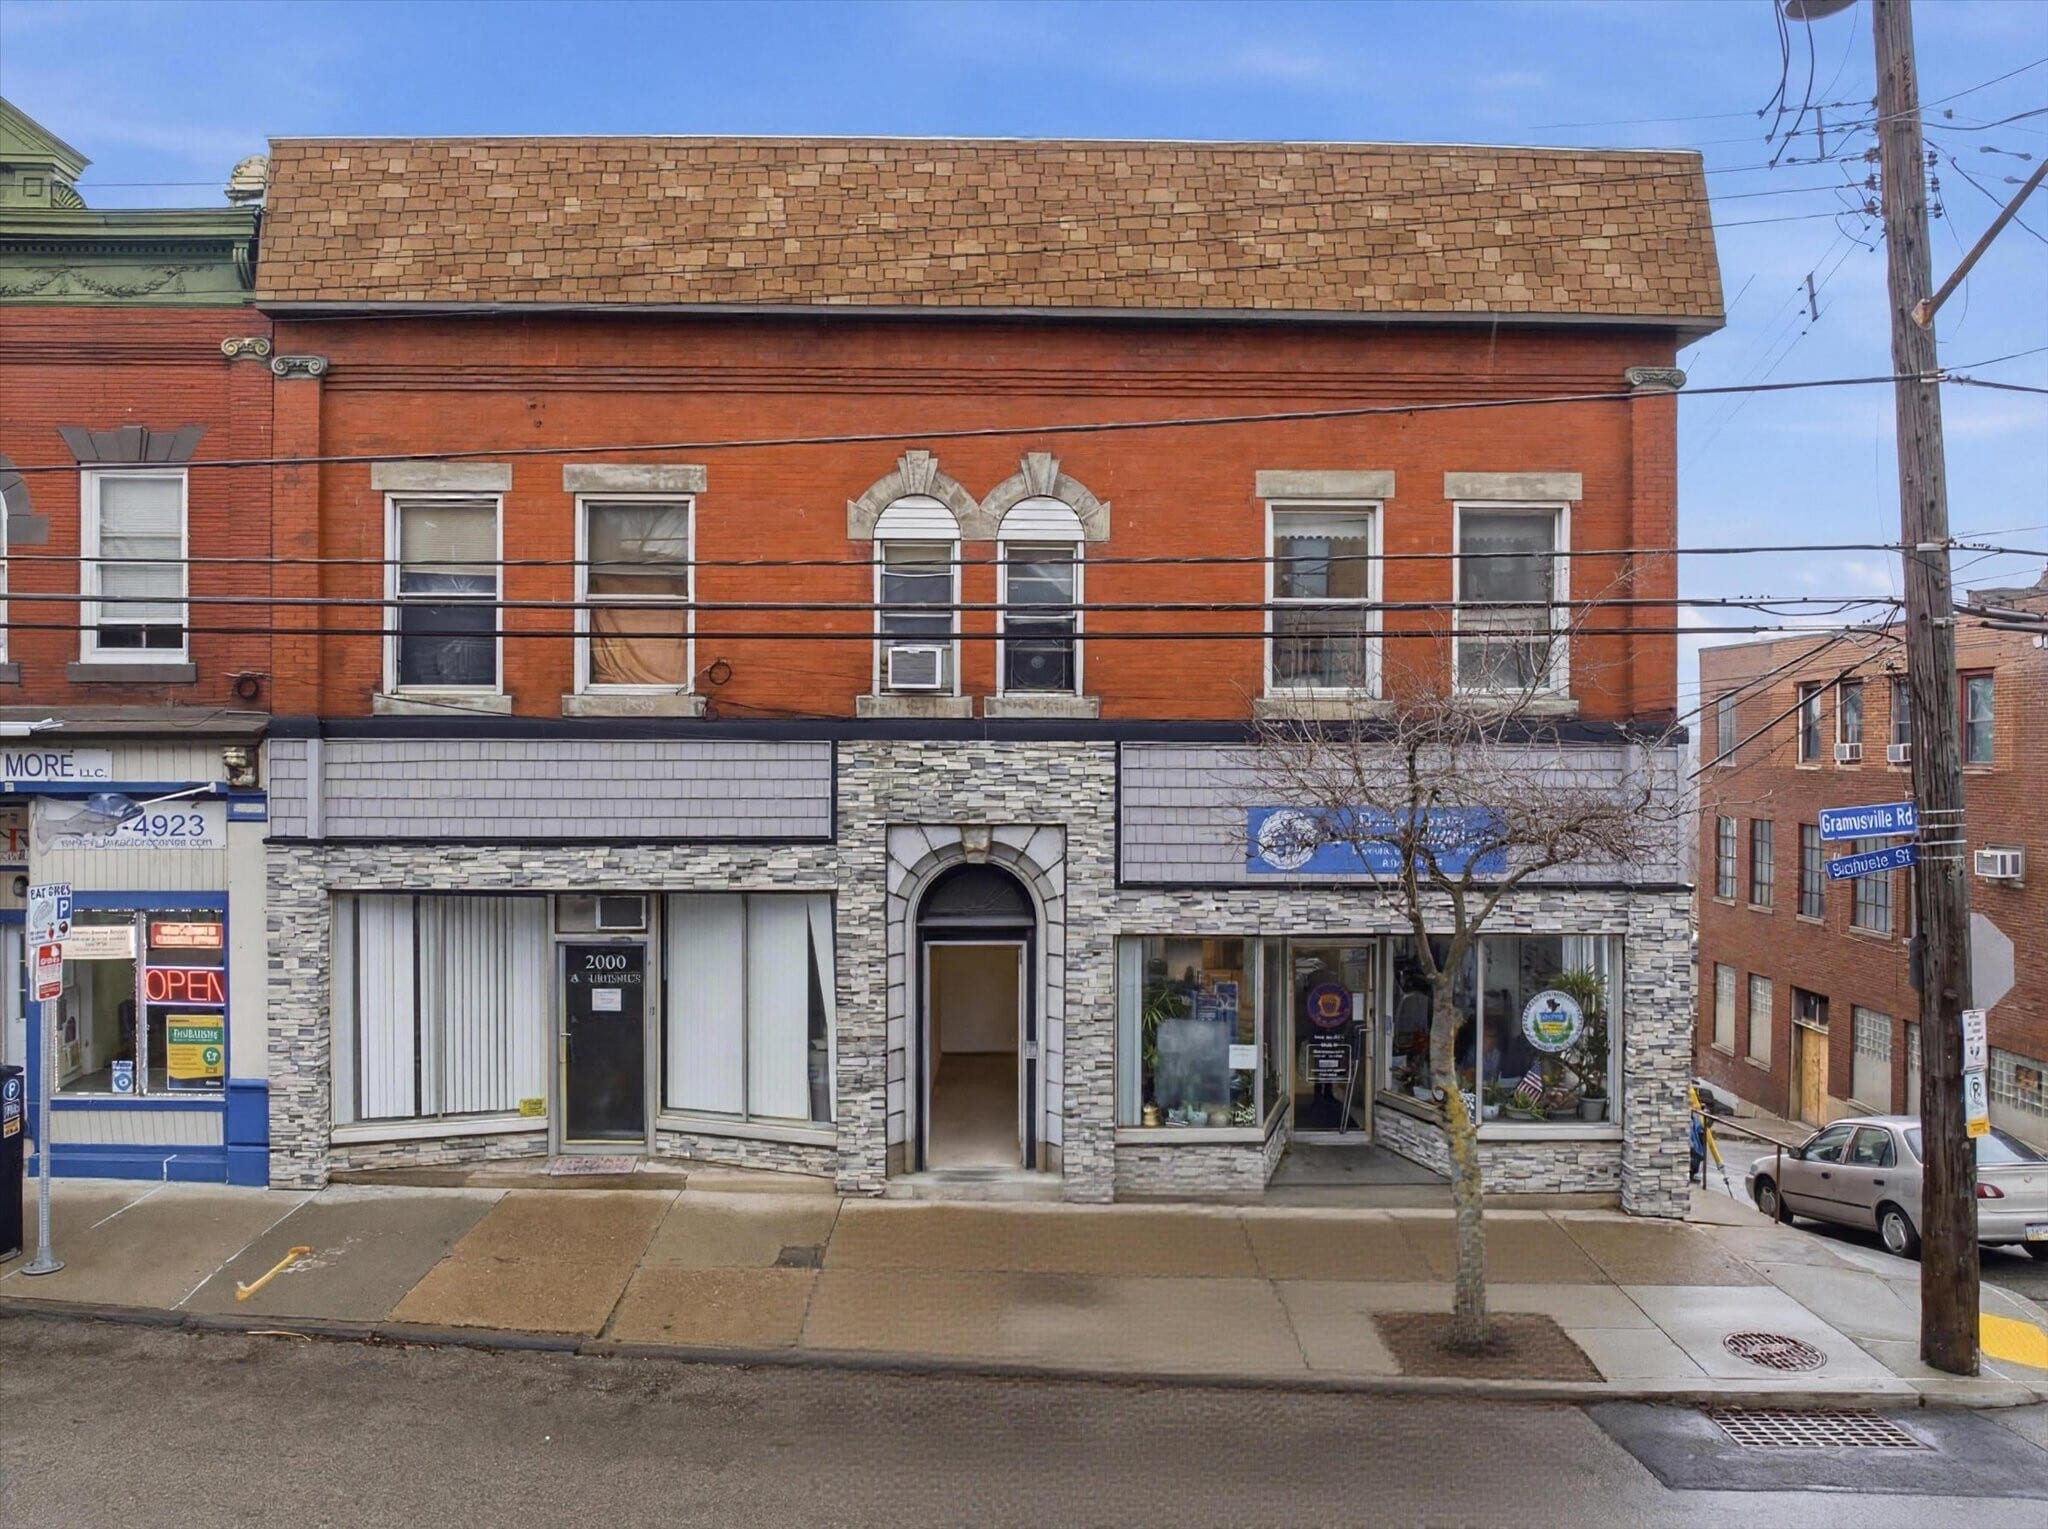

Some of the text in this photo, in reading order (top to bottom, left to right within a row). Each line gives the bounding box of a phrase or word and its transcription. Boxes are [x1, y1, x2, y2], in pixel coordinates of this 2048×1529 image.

[5, 753, 74, 777] MORE
[1896, 806, 1914, 827] Rd
[1895, 847, 1912, 864] St
[585, 954, 627, 970] 2000
[146, 969, 225, 1002] OPEN
